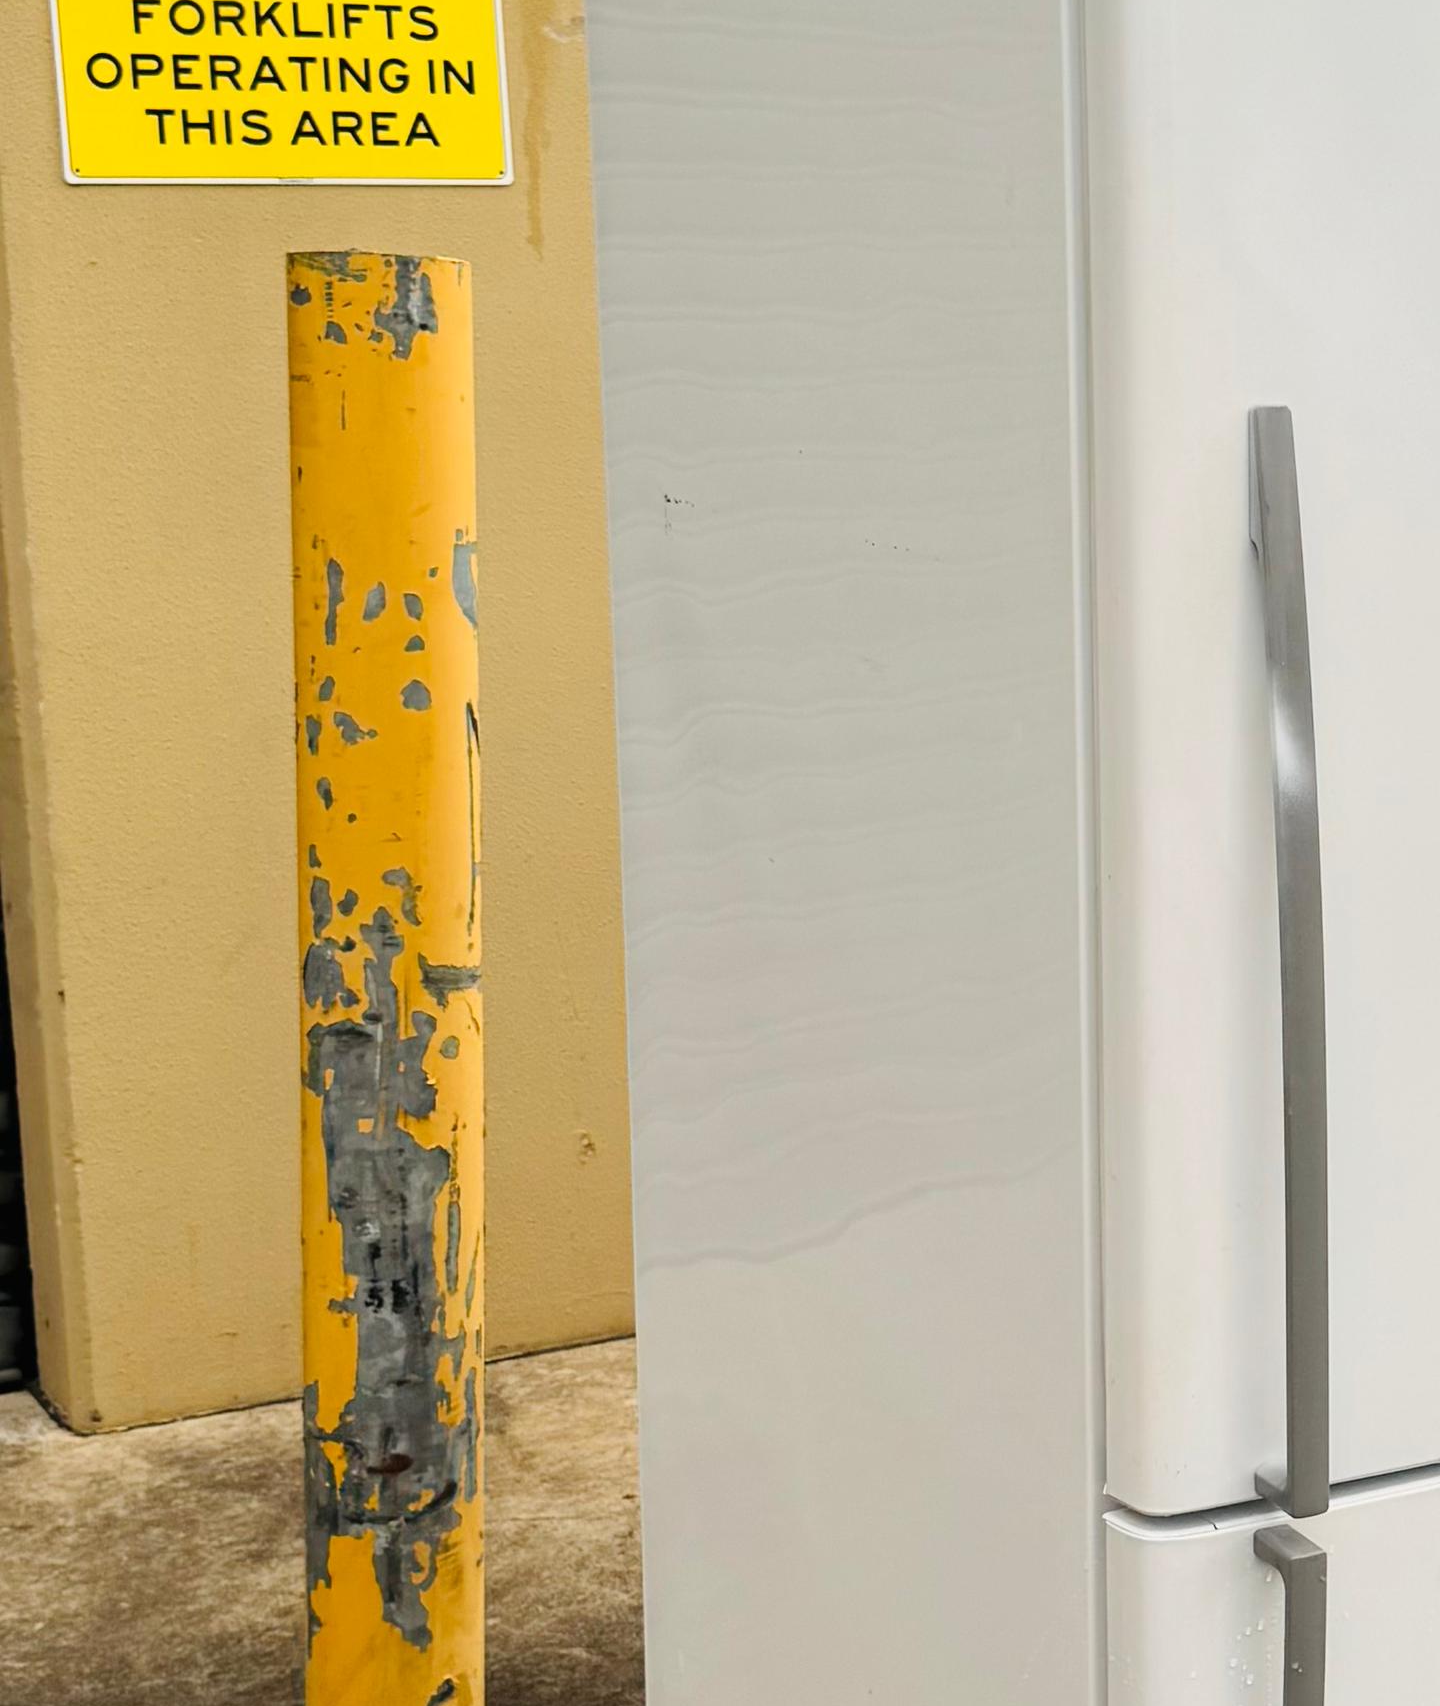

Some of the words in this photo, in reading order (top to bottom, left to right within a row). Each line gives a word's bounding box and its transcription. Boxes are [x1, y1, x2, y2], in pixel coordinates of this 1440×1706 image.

[86, 52, 410, 94] OPERATING
[427, 59, 475, 95] IN
[144, 108, 273, 146] THIS
[290, 110, 440, 147] AREA
